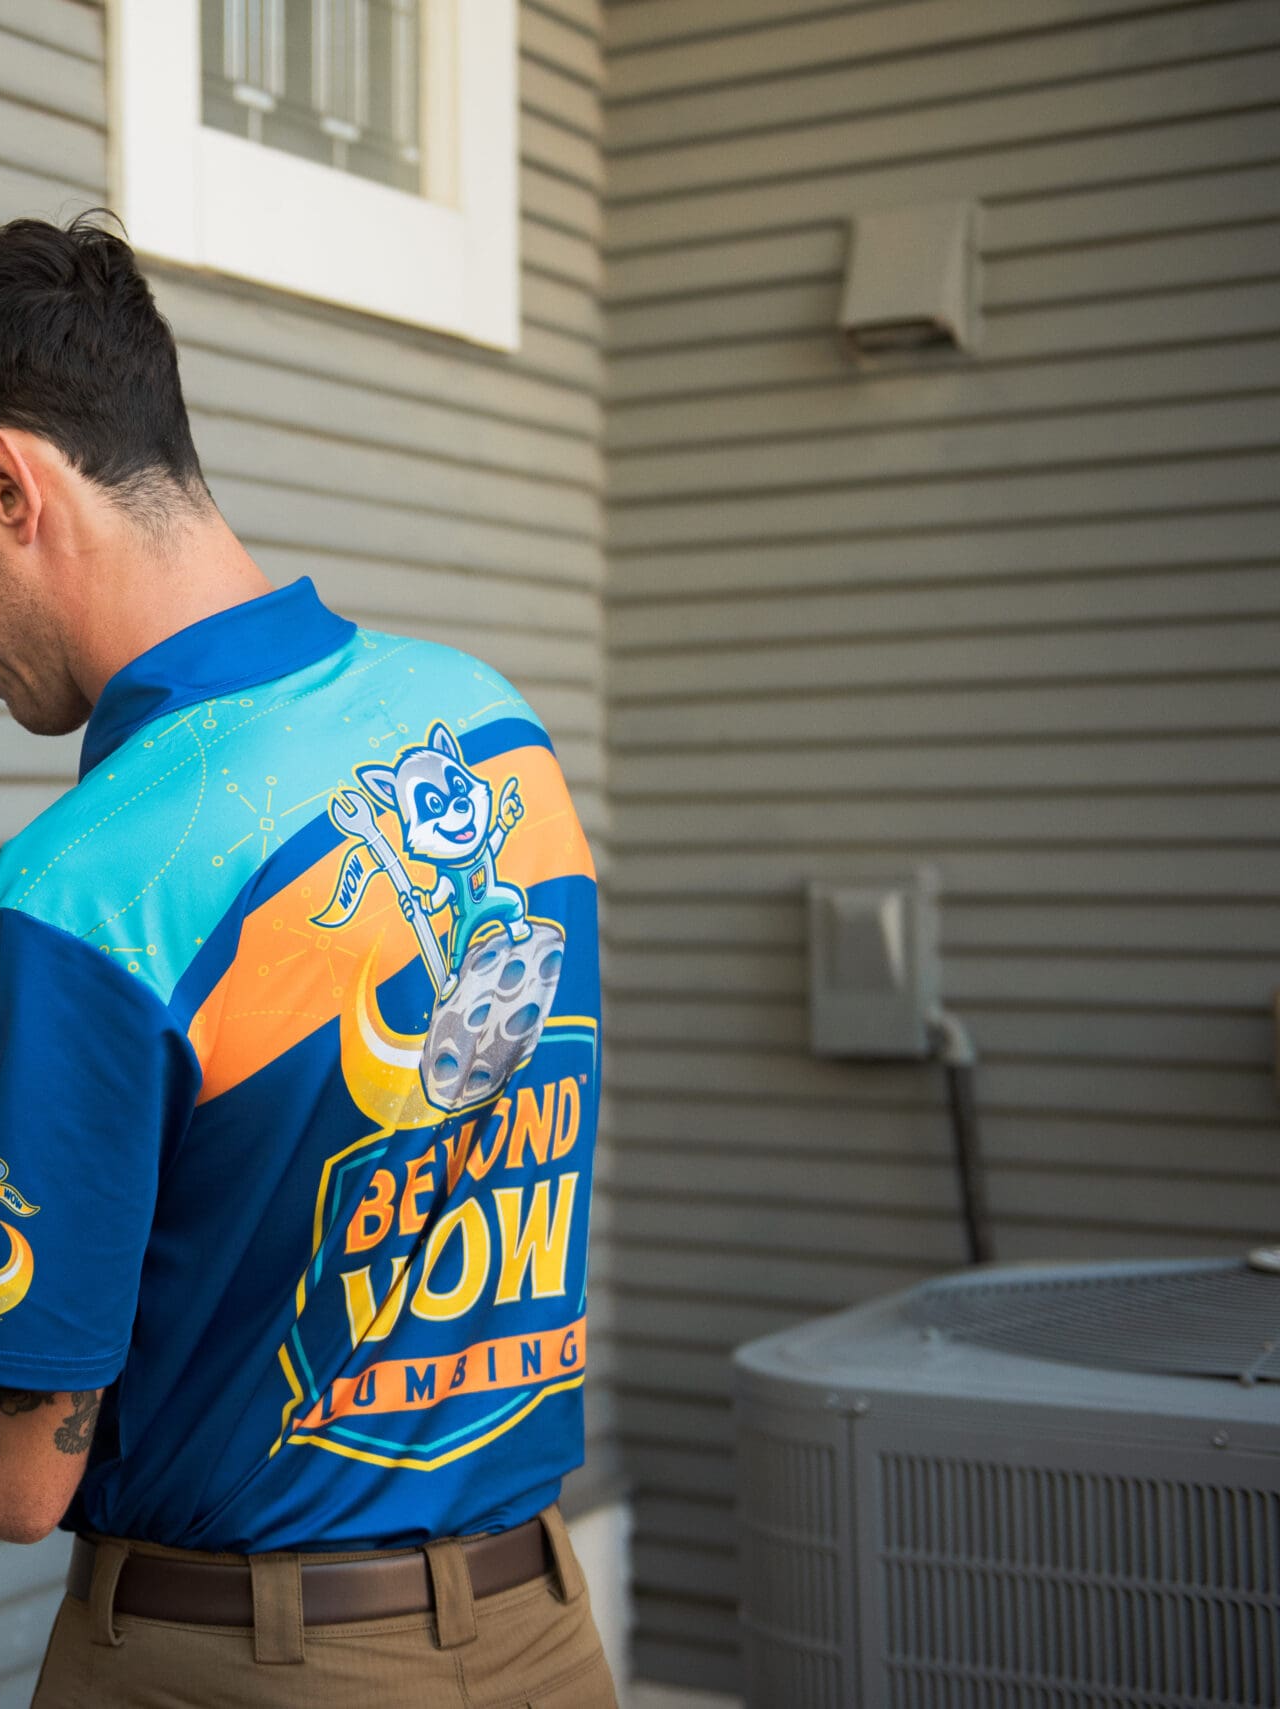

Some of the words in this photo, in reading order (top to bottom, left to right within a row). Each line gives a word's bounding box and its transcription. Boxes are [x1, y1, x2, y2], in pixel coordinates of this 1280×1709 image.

[339, 854, 364, 910] WOW
[471, 867, 485, 890] BW
[4, 1188, 23, 1210] WOW
[321, 1331, 578, 1420] LUMBING
